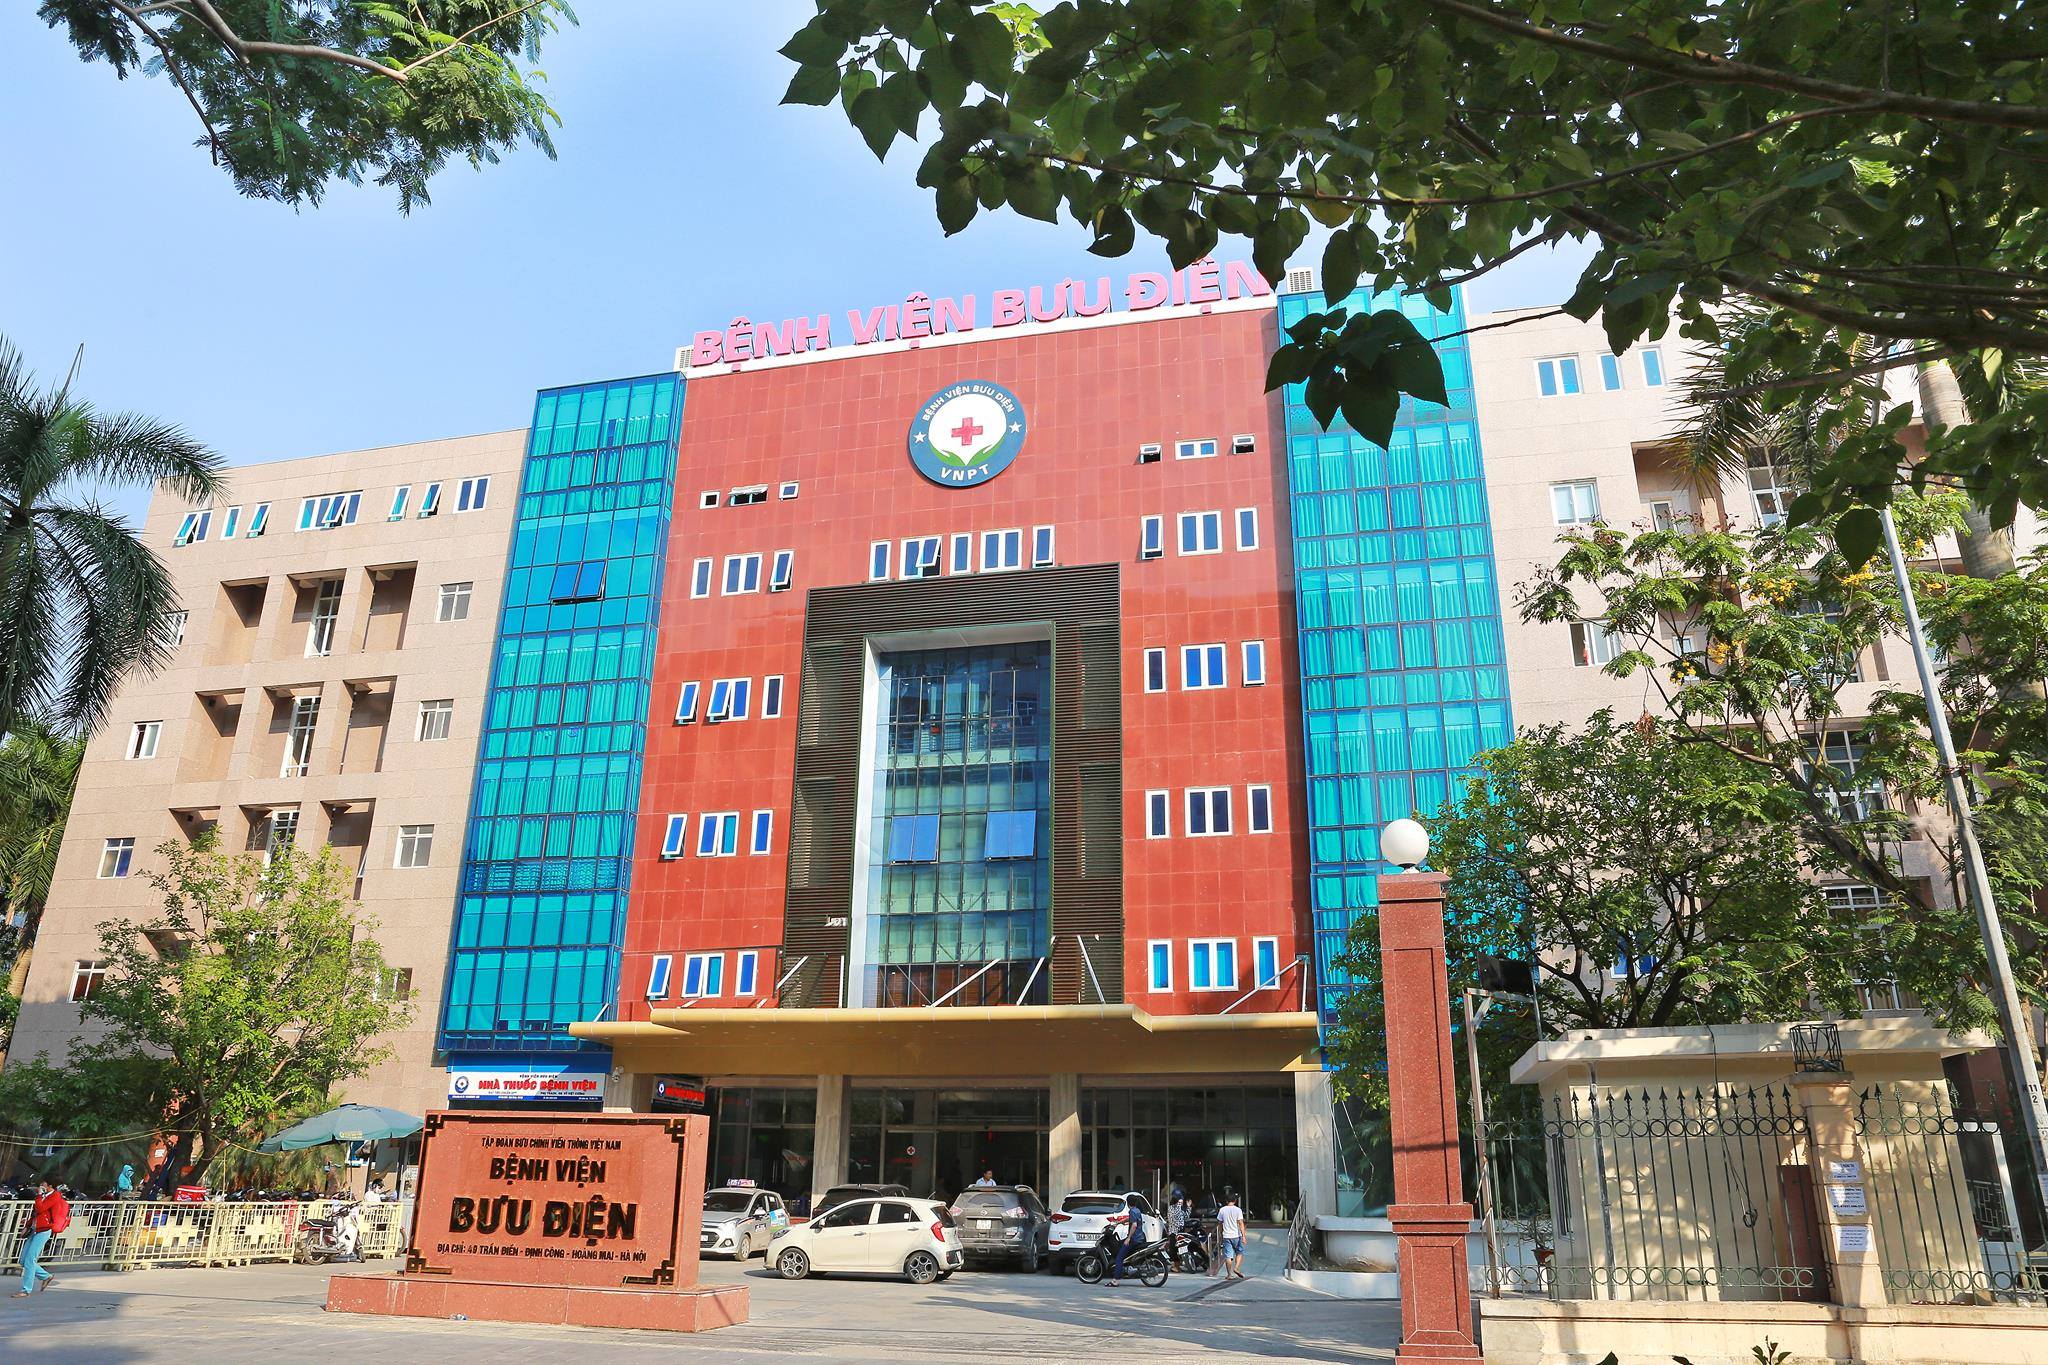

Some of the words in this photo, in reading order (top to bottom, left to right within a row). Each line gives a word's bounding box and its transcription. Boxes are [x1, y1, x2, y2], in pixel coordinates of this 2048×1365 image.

[690, 316, 831, 373] BỆNH
[848, 291, 976, 349] VIỆN
[992, 277, 1112, 328] BƯU
[1125, 255, 1271, 314] ĐIỆN
[922, 396, 945, 421] BỆNH
[945, 385, 970, 399] VIỆN
[972, 385, 995, 396] BƯU
[941, 464, 989, 481] VNPT
[478, 1079, 500, 1090] NHÀ
[503, 1078, 537, 1091] THUỐC
[540, 1079, 569, 1092] BỆNH
[572, 1079, 597, 1092] VIỆN
[2032, 1095, 2038, 1103] 2
[482, 1136, 495, 1149] TẬP
[514, 1138, 529, 1148] BƯU
[529, 1136, 549, 1148] CHÍNH
[590, 1138, 604, 1152] VIỆT
[605, 1140, 621, 1150] NAM
[490, 1153, 549, 1185] BỆNH
[555, 1155, 606, 1188] VIỆN
[449, 1194, 532, 1236] BƯU
[542, 1194, 637, 1246] ĐIỆN
[437, 1243, 450, 1254] ĐỊA
[525, 1247, 543, 1258] ĐỊNH
[572, 1248, 598, 1260] HOÀNG
[598, 1251, 614, 1260] MAI
[620, 1249, 631, 1261] HÀ
[633, 1250, 647, 1263] NỘI
